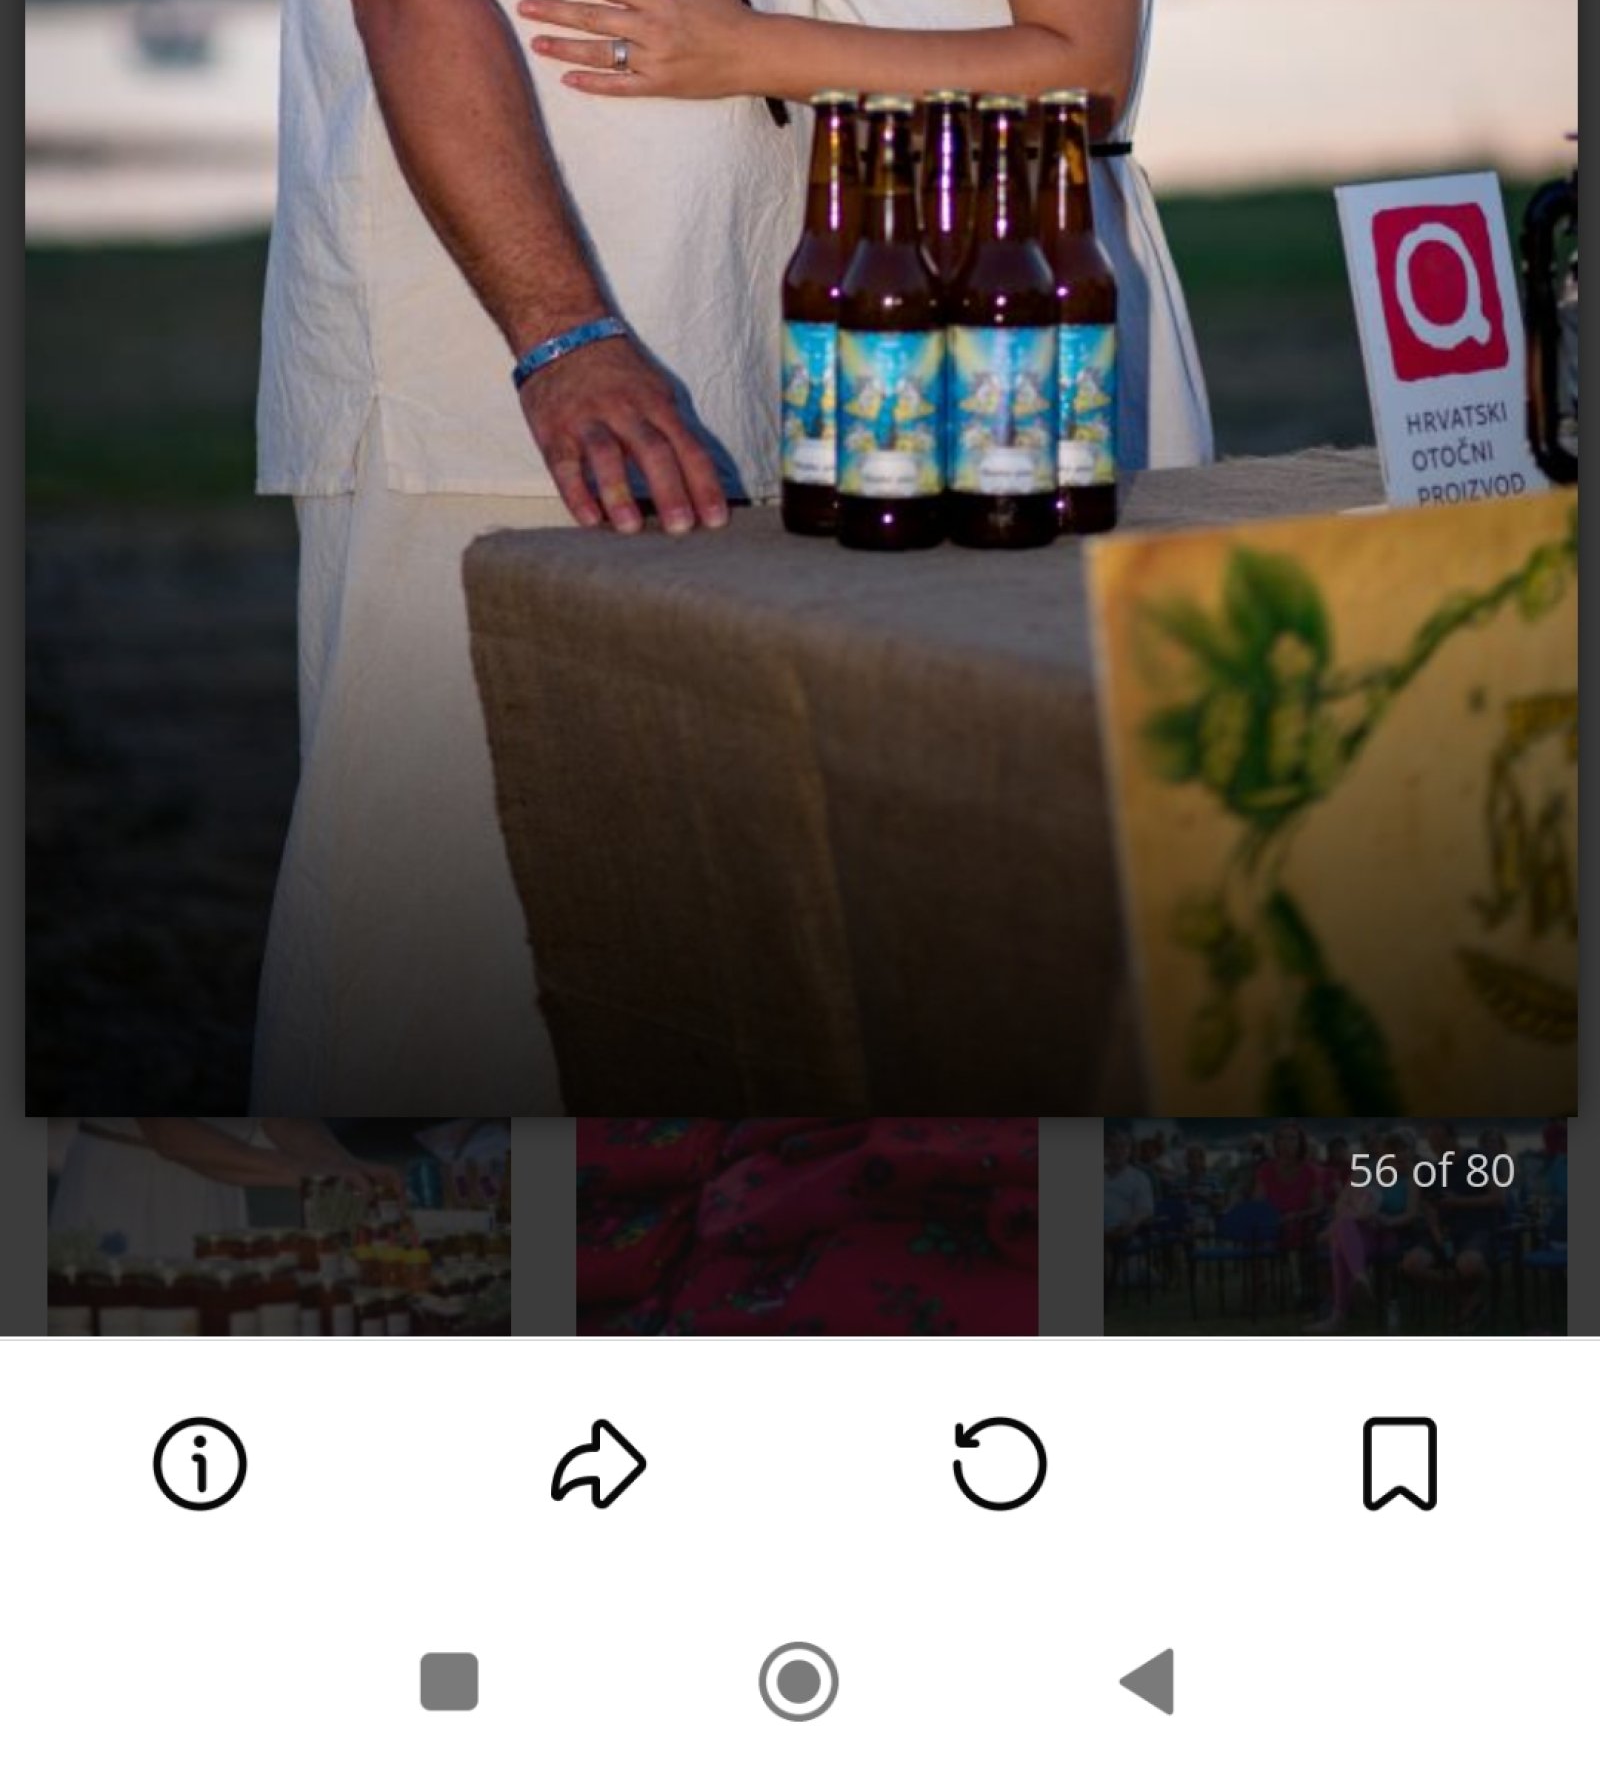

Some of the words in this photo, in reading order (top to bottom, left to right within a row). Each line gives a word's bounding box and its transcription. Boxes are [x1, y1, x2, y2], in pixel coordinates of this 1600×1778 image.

[1406, 400, 1508, 435] HRVATSKI
[1411, 436, 1494, 471] OTOČNI
[1417, 473, 1526, 508] PROIZVOD
